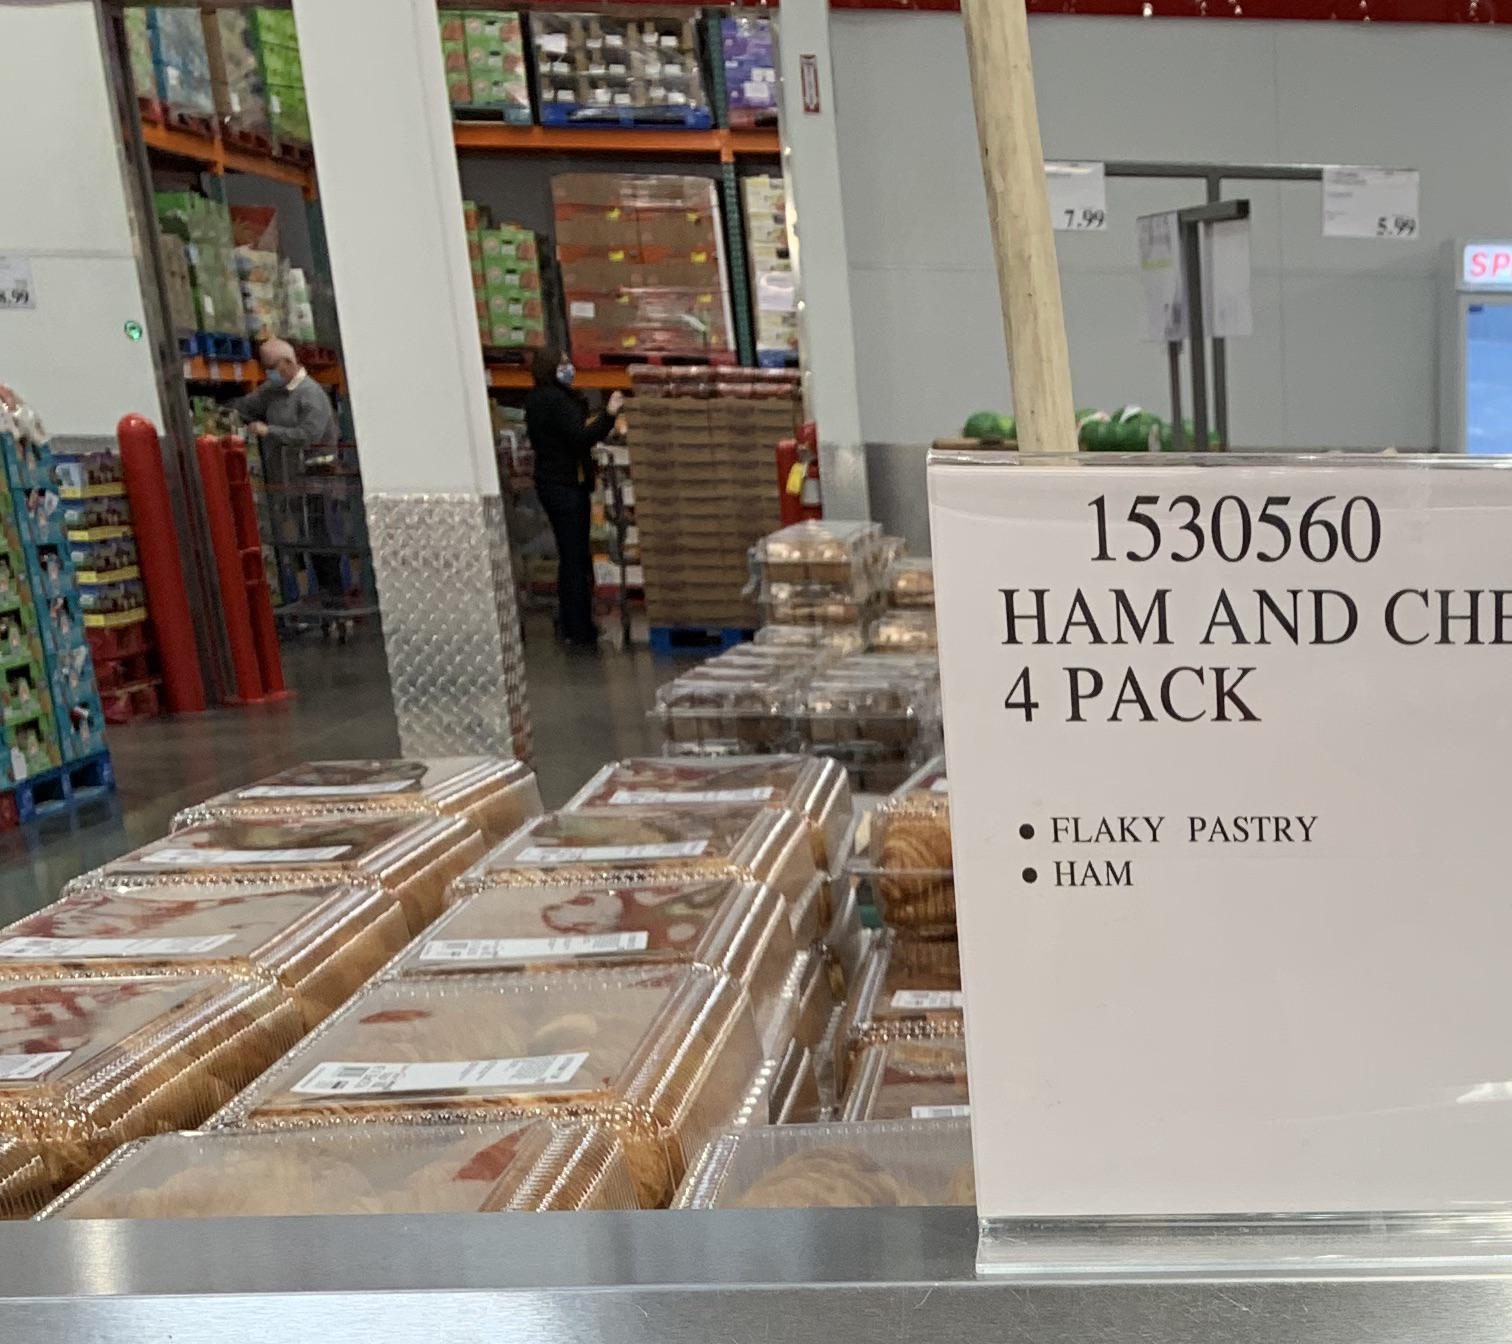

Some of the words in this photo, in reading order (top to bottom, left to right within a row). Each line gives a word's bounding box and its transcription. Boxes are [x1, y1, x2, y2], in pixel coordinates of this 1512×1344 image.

[1091, 496, 1380, 564] 1530560
[998, 589, 1172, 646] HAM
[1202, 589, 1358, 647] AND
[1004, 666, 1039, 723] 4
[1064, 665, 1261, 723] PACK
[1052, 815, 1164, 844] FLAKY
[1189, 815, 1318, 844] PASTRY
[1053, 860, 1134, 887] HAM
